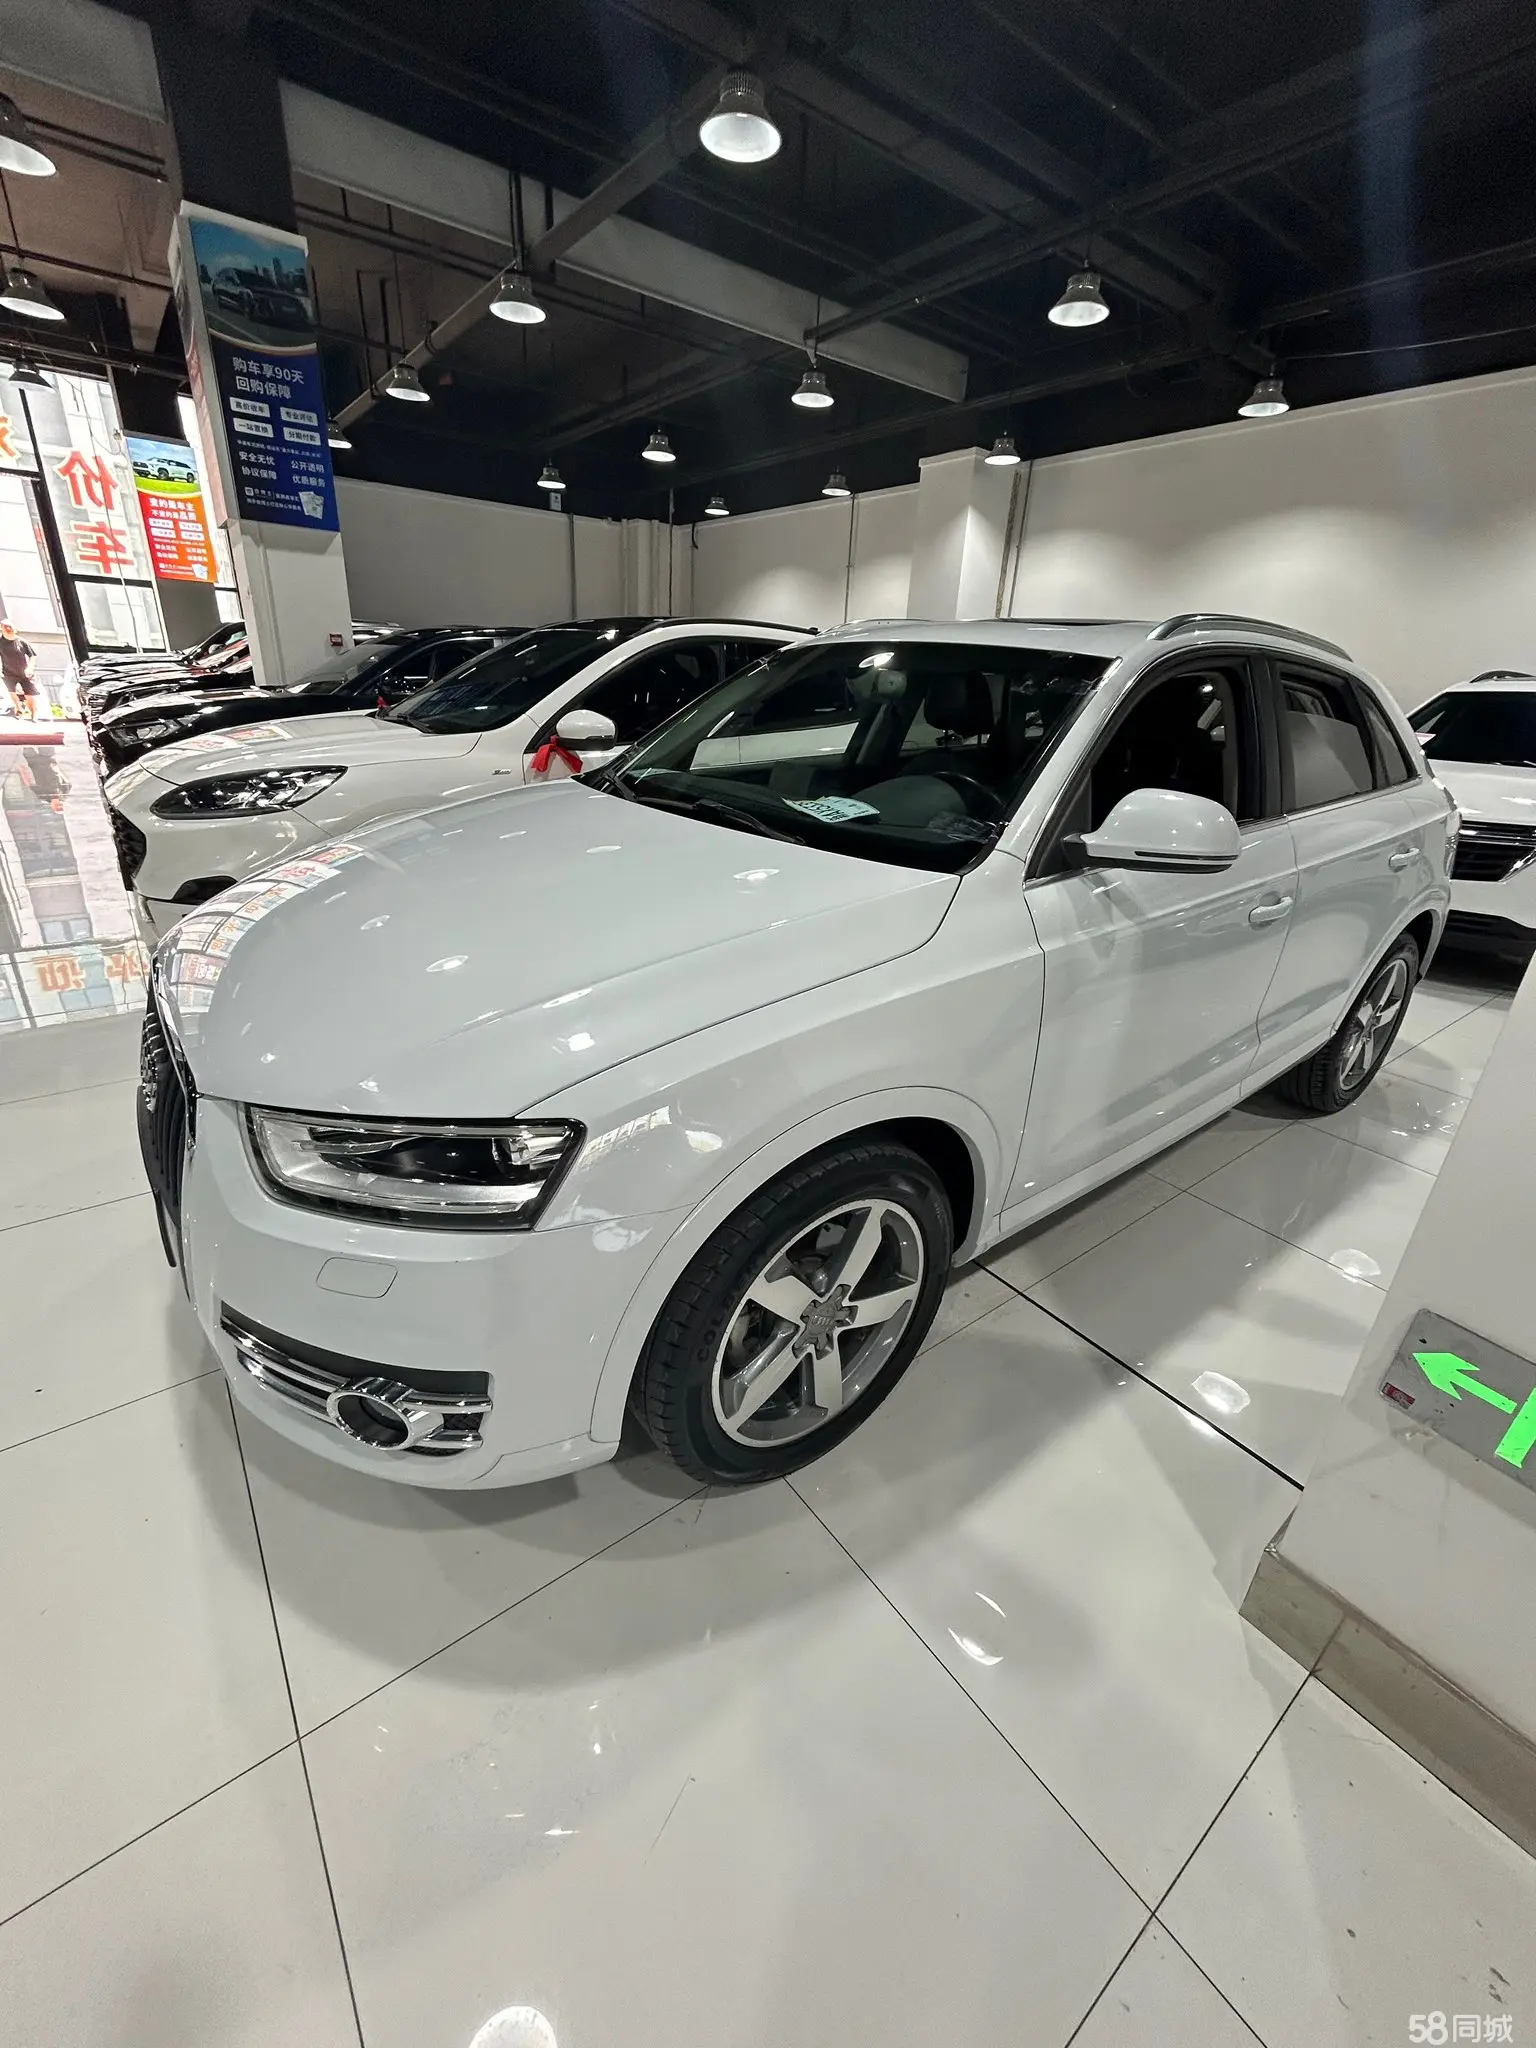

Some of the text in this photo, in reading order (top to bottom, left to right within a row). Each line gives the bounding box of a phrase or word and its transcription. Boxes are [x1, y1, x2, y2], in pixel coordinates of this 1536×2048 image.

[232, 356, 304, 384] 购车享90天
[235, 375, 291, 399] 回购保障
[238, 450, 275, 465] 安全无忧
[241, 465, 277, 480] 协议保障
[290, 459, 325, 473] 公开透明
